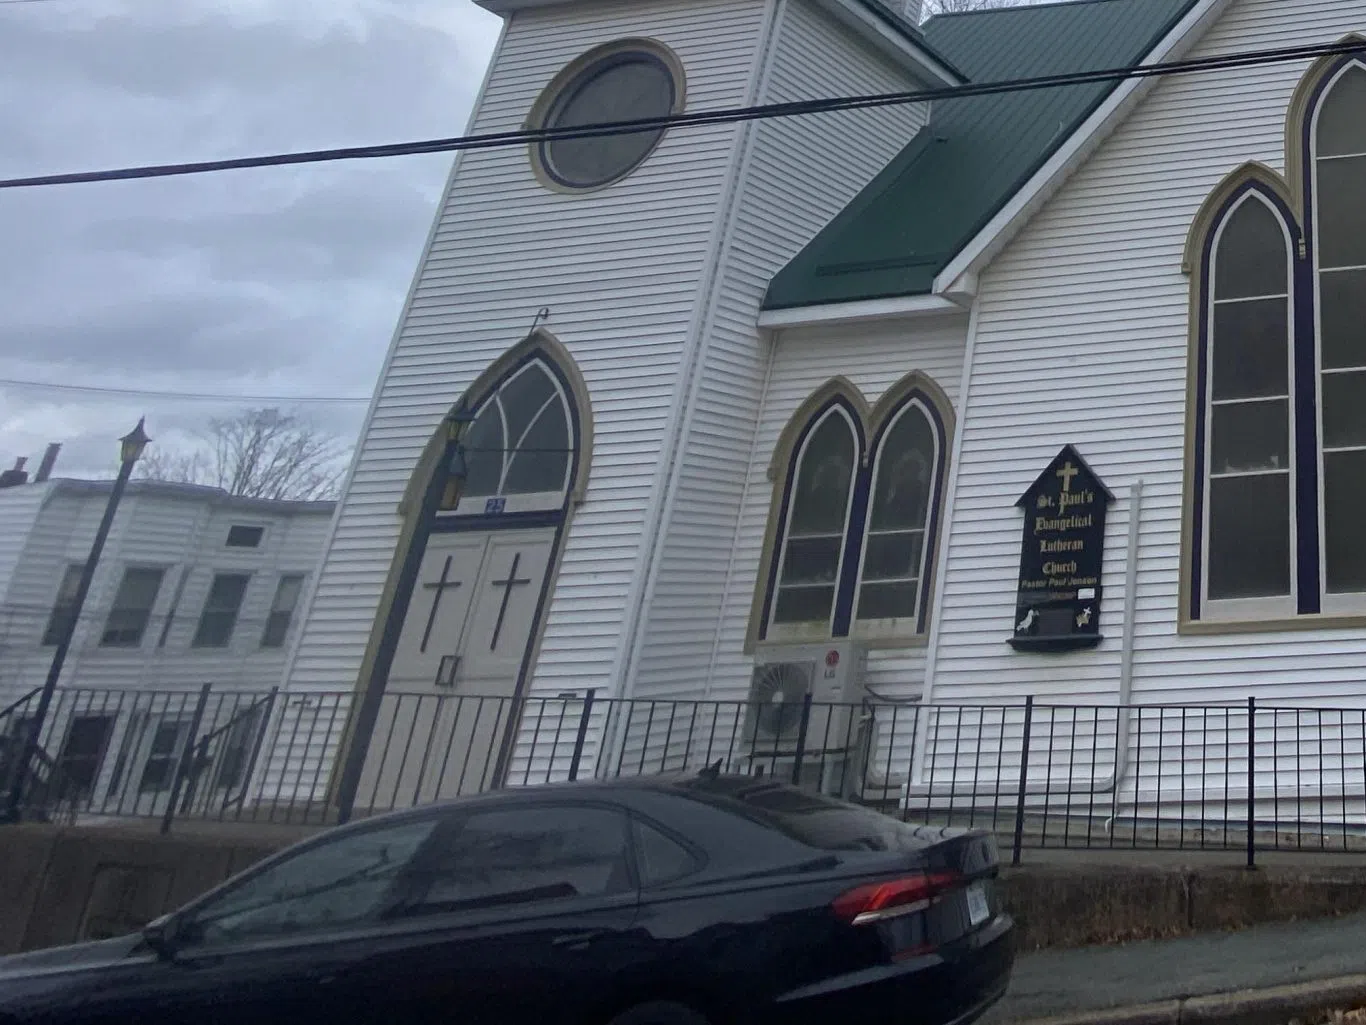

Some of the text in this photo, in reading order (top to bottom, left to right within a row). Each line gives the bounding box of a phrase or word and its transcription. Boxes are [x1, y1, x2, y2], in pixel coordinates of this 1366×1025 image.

[1037, 489, 1094, 516] St. Paul's
[1034, 514, 1092, 534] Evangelical
[1040, 539, 1083, 552] Lutheran
[1042, 560, 1077, 576] Church
[1022, 579, 1047, 588] Pastor
